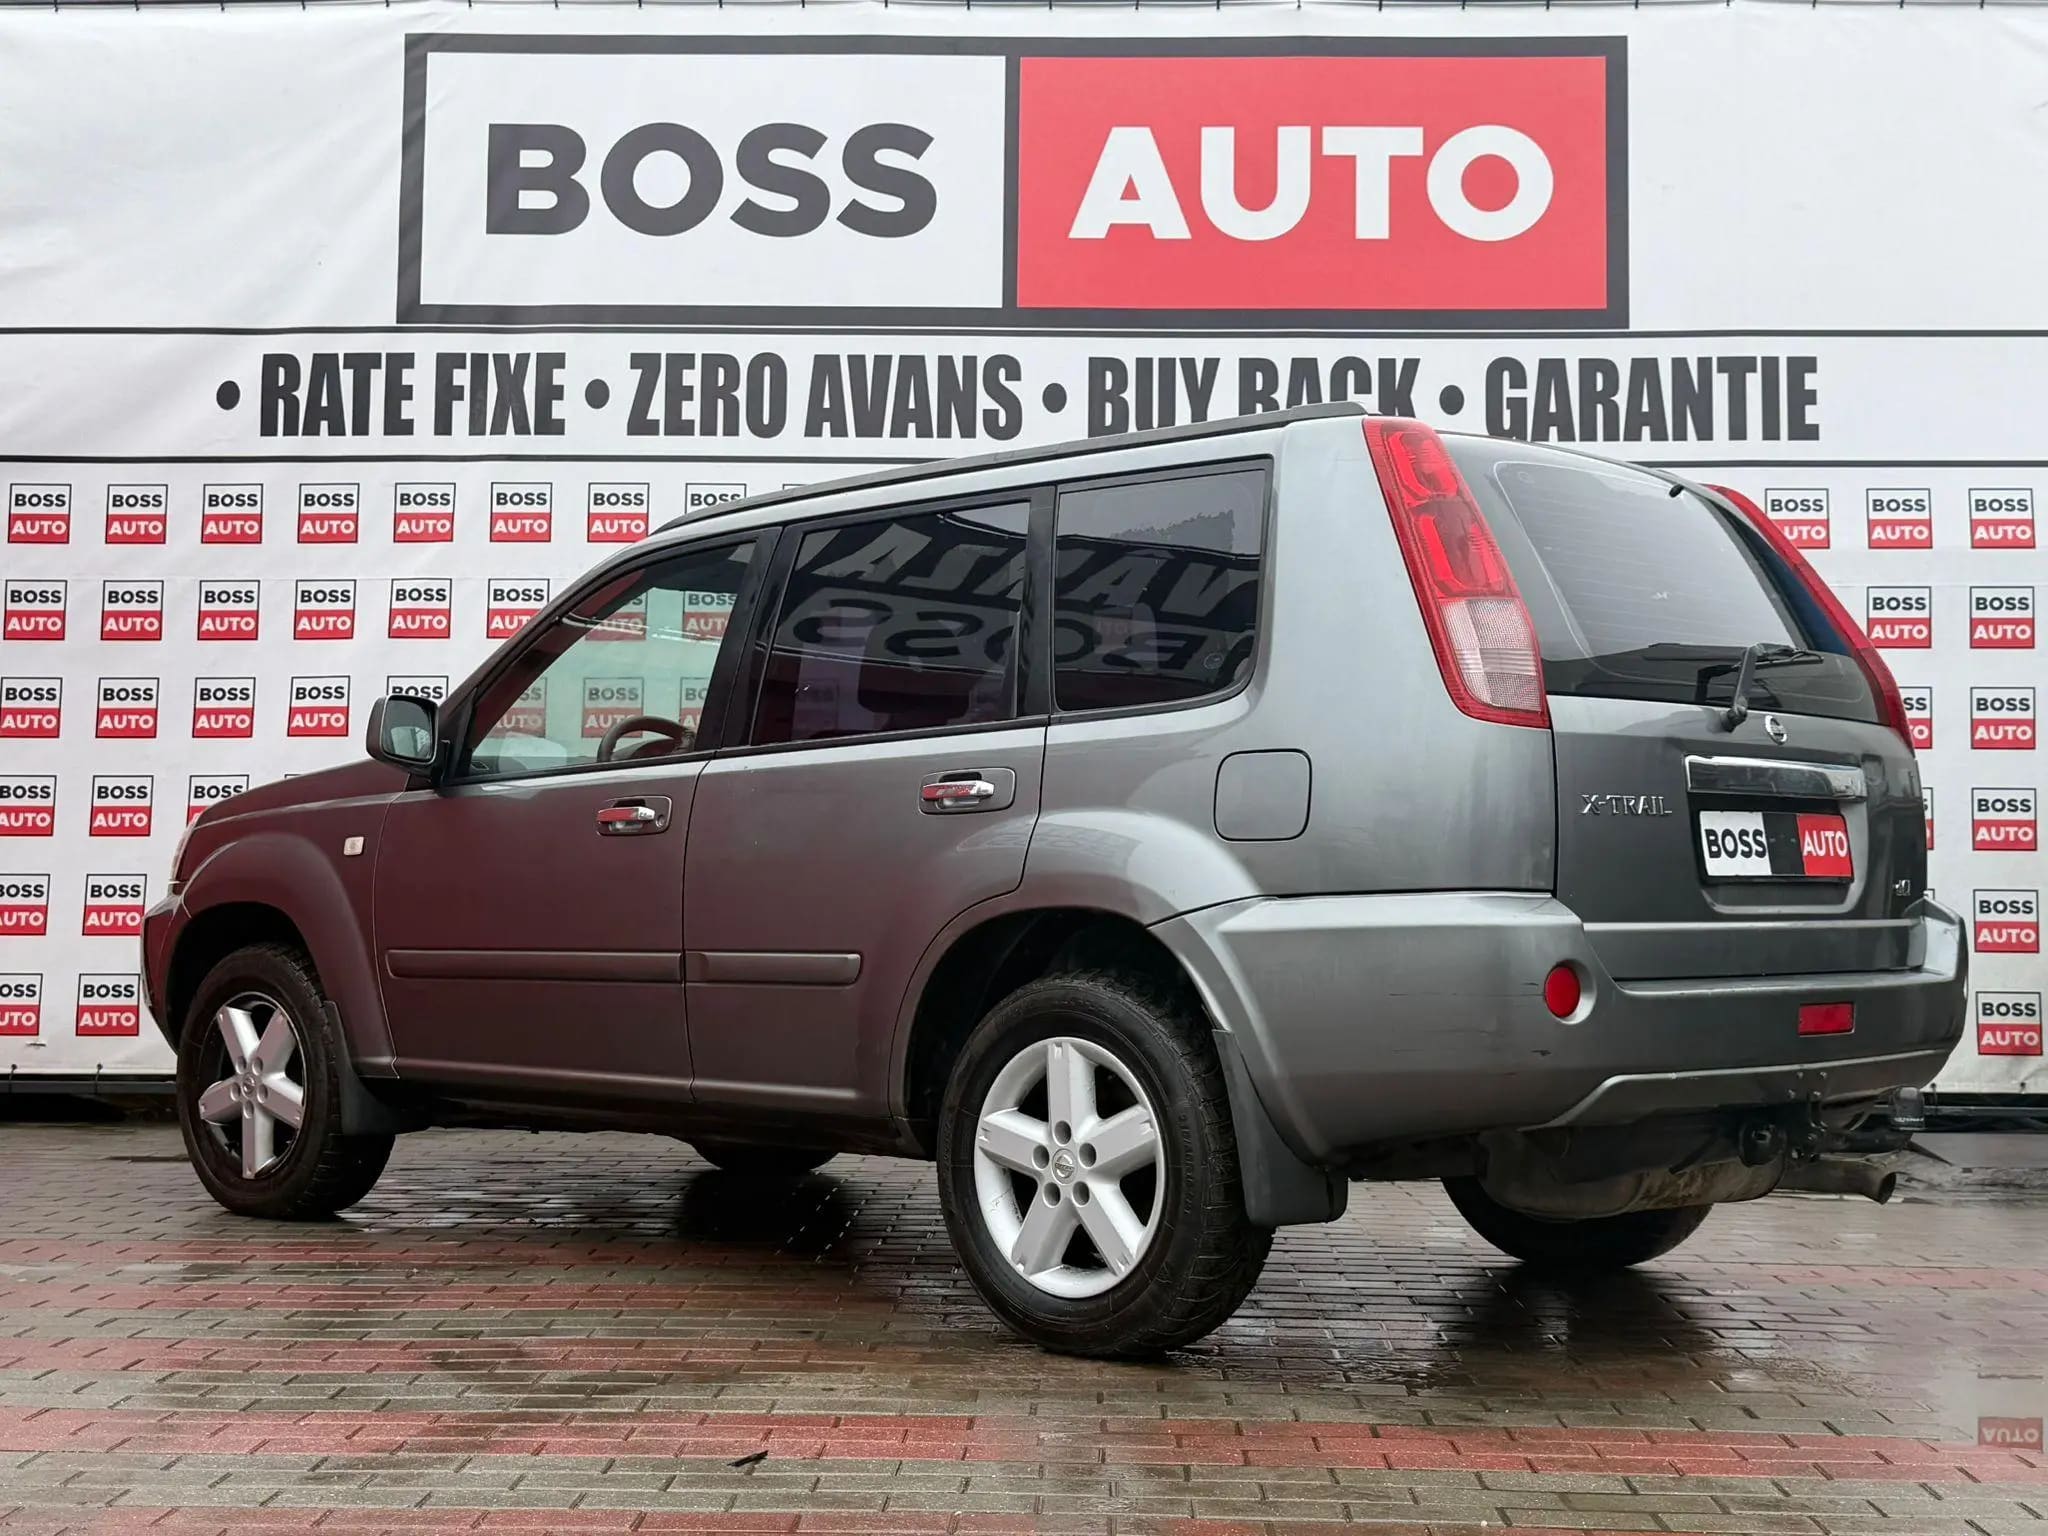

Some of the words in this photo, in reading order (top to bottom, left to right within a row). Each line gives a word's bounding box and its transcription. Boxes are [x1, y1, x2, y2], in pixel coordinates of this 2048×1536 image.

[486, 122, 937, 237] BOSS
[1068, 125, 1554, 242] AUTO
[260, 352, 414, 437] RATE
[434, 352, 566, 436] FIXE
[626, 352, 788, 438] ZERO
[804, 353, 1023, 440] AVANS
[1087, 355, 1221, 438] BUY
[1484, 355, 1821, 441] GARANTIE
[15, 494, 66, 507] BOSS
[112, 494, 162, 507] BOSS
[209, 494, 258, 507] BOSS
[304, 494, 354, 506] BOSS
[400, 493, 450, 506] BOSS
[497, 493, 546, 505] BOSS
[594, 493, 644, 506] BOSS
[1771, 498, 1824, 512] BOSS
[1874, 499, 1926, 511] BOSS
[1975, 499, 2028, 511] BOSS
[12, 521, 66, 534] AUTO
[109, 521, 163, 534] AUTO
[205, 521, 259, 534] AUTO
[301, 520, 355, 534] AUTO
[396, 519, 451, 533] AUTO
[493, 519, 548, 533] AUTO
[591, 519, 646, 533] AUTO
[1783, 525, 1826, 540] UTO
[1872, 525, 1929, 540] AUTO
[1975, 525, 2032, 540] AUTO
[11, 590, 62, 603] BOSS
[108, 591, 158, 603] BOSS
[205, 590, 255, 603] BOSS
[301, 590, 350, 603] BOSS
[396, 588, 447, 601] BOSS
[493, 589, 544, 601] BOSS
[1872, 597, 1926, 610] BOSS
[1976, 597, 2029, 610] BOSS
[8, 617, 62, 631] AUTO
[104, 617, 159, 631] AUTO
[202, 617, 256, 631] AUTO
[297, 616, 352, 630] AUTO
[392, 615, 447, 629] AUTO
[490, 615, 532, 629] AUT
[1870, 625, 1928, 639] AUTO
[1973, 625, 2031, 639] AUTO
[5, 687, 57, 701] BOSS
[103, 688, 153, 701] BOSS
[200, 688, 250, 701] BOSS
[296, 686, 345, 700] BOSS
[588, 687, 639, 700] BOSS
[1977, 698, 2030, 711] BOSS
[2, 715, 57, 728] AUTO
[99, 715, 154, 728] AUTO
[196, 715, 251, 728] AUTO
[291, 713, 346, 727] AUTO
[1974, 726, 2032, 740] AUTO
[0, 786, 51, 799] BOSS
[97, 786, 147, 799] BOSS
[1580, 794, 1673, 815] X-TRAIL
[1978, 799, 2032, 812] BOSS
[93, 813, 148, 827] AUTO
[1976, 827, 2034, 841] AUTO
[1704, 829, 1767, 858] BOSS
[1802, 830, 1848, 857] AUTO
[91, 885, 141, 898] BOSS
[1979, 900, 2034, 914] BOSS
[0, 912, 44, 926] UTO
[86, 912, 141, 926] AUTO
[1978, 929, 2036, 943] AUTO
[83, 984, 134, 998] BOSS
[1982, 1003, 2036, 1017] BOSS
[80, 1012, 135, 1026] AUTO
[1981, 1031, 2039, 1045] AUTO
